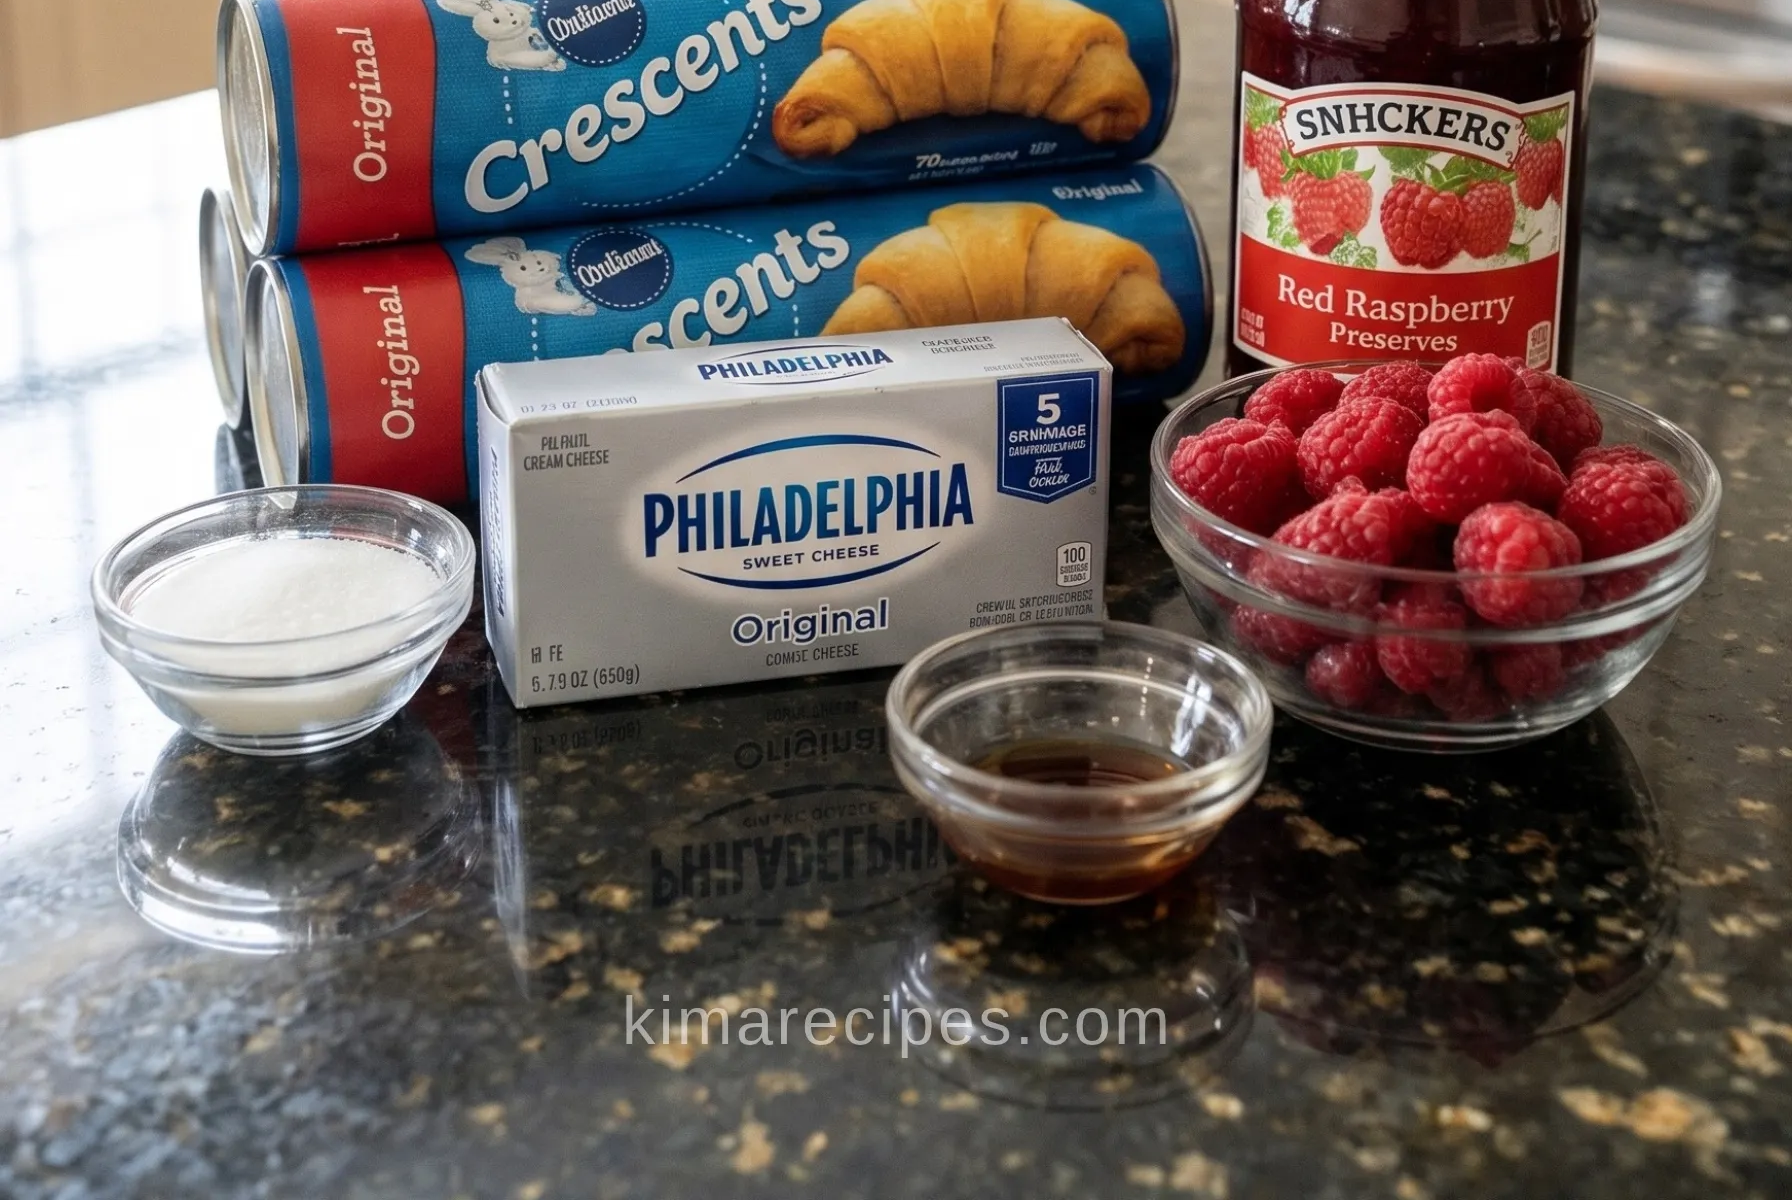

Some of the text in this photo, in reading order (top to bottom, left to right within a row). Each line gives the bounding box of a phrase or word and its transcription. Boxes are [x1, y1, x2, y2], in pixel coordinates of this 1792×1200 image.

[337, 26, 392, 183] Original
[1295, 101, 1512, 152] SNHCKERS
[1052, 179, 1144, 201] Original
[1277, 273, 1515, 328] Red Raspberry
[1329, 321, 1458, 352] Preserves
[363, 285, 420, 439] Original
[697, 348, 894, 381] PHILADELPHIA
[1036, 392, 1061, 425] 5
[523, 450, 610, 471] CREAM CHEESE
[643, 463, 974, 559] PHILADELPHIA
[743, 544, 880, 570] SWEET CHEESE
[1063, 546, 1086, 564] 100
[731, 597, 889, 646] Original
[813, 643, 859, 661] CHEESE
[593, 663, 640, 689] (650g)
